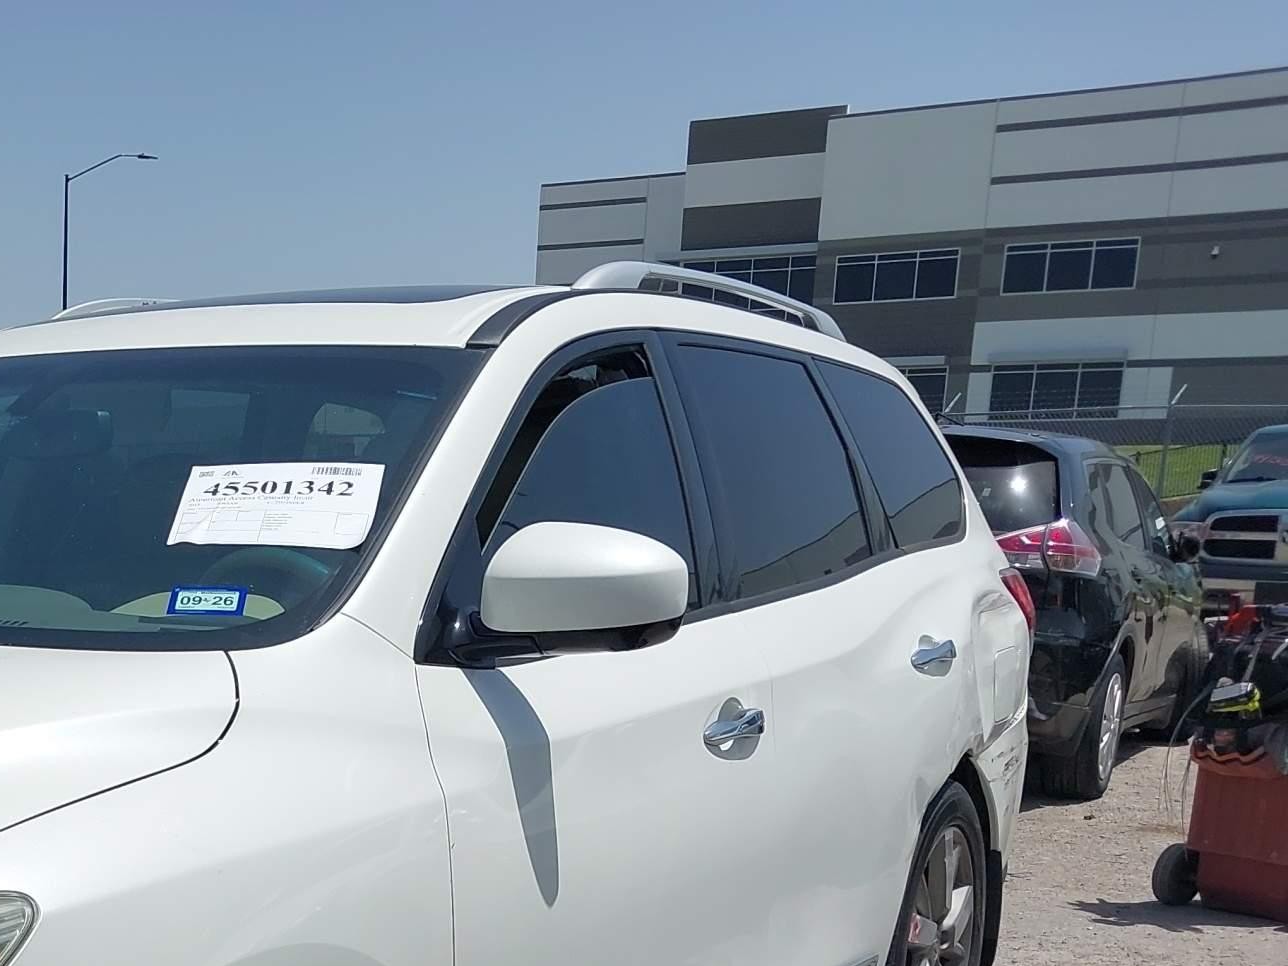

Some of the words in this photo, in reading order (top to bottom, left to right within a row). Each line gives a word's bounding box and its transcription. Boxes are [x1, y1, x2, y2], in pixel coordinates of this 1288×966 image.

[203, 480, 355, 497] 45501342
[180, 595, 203, 606] 09
[211, 595, 235, 606] 26
